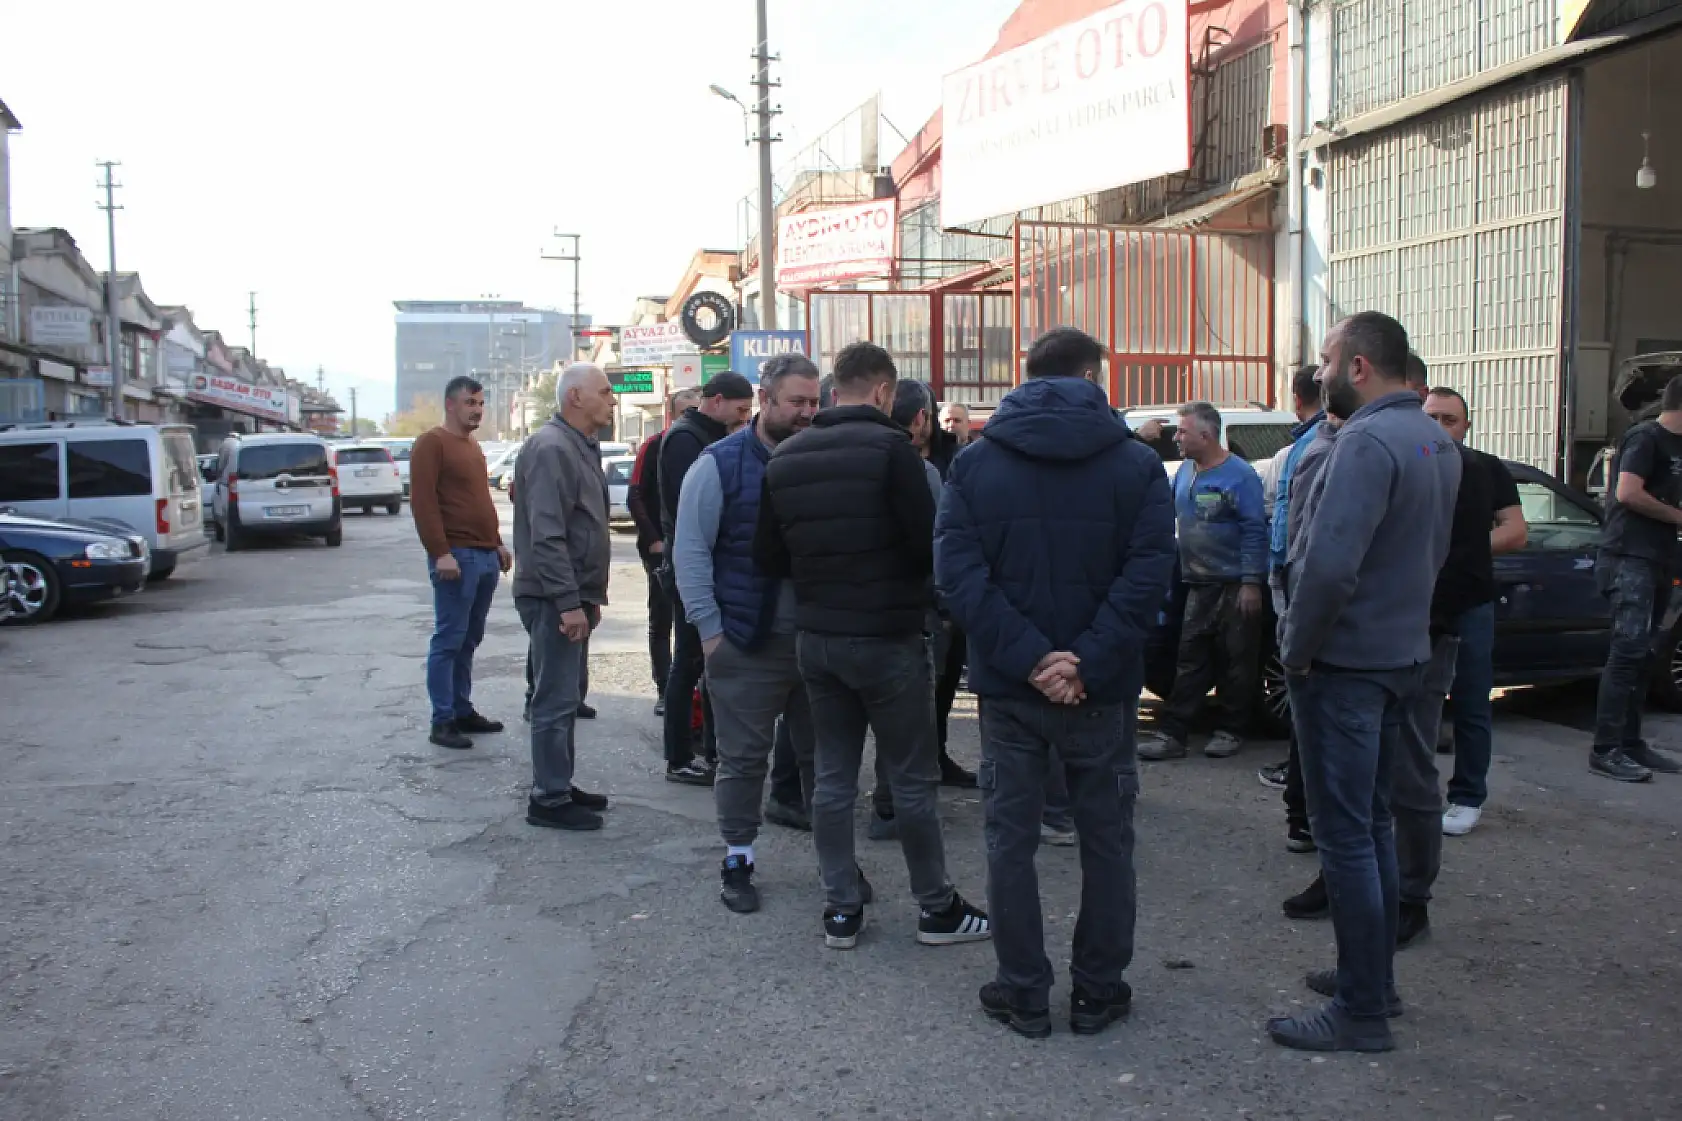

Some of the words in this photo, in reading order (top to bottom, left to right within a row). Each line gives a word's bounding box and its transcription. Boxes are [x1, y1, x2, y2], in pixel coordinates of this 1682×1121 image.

[1074, 1, 1168, 80] OTO
[843, 207, 888, 233] OTO
[623, 326, 665, 338] AYVAZ
[743, 334, 803, 357] KLİMA
